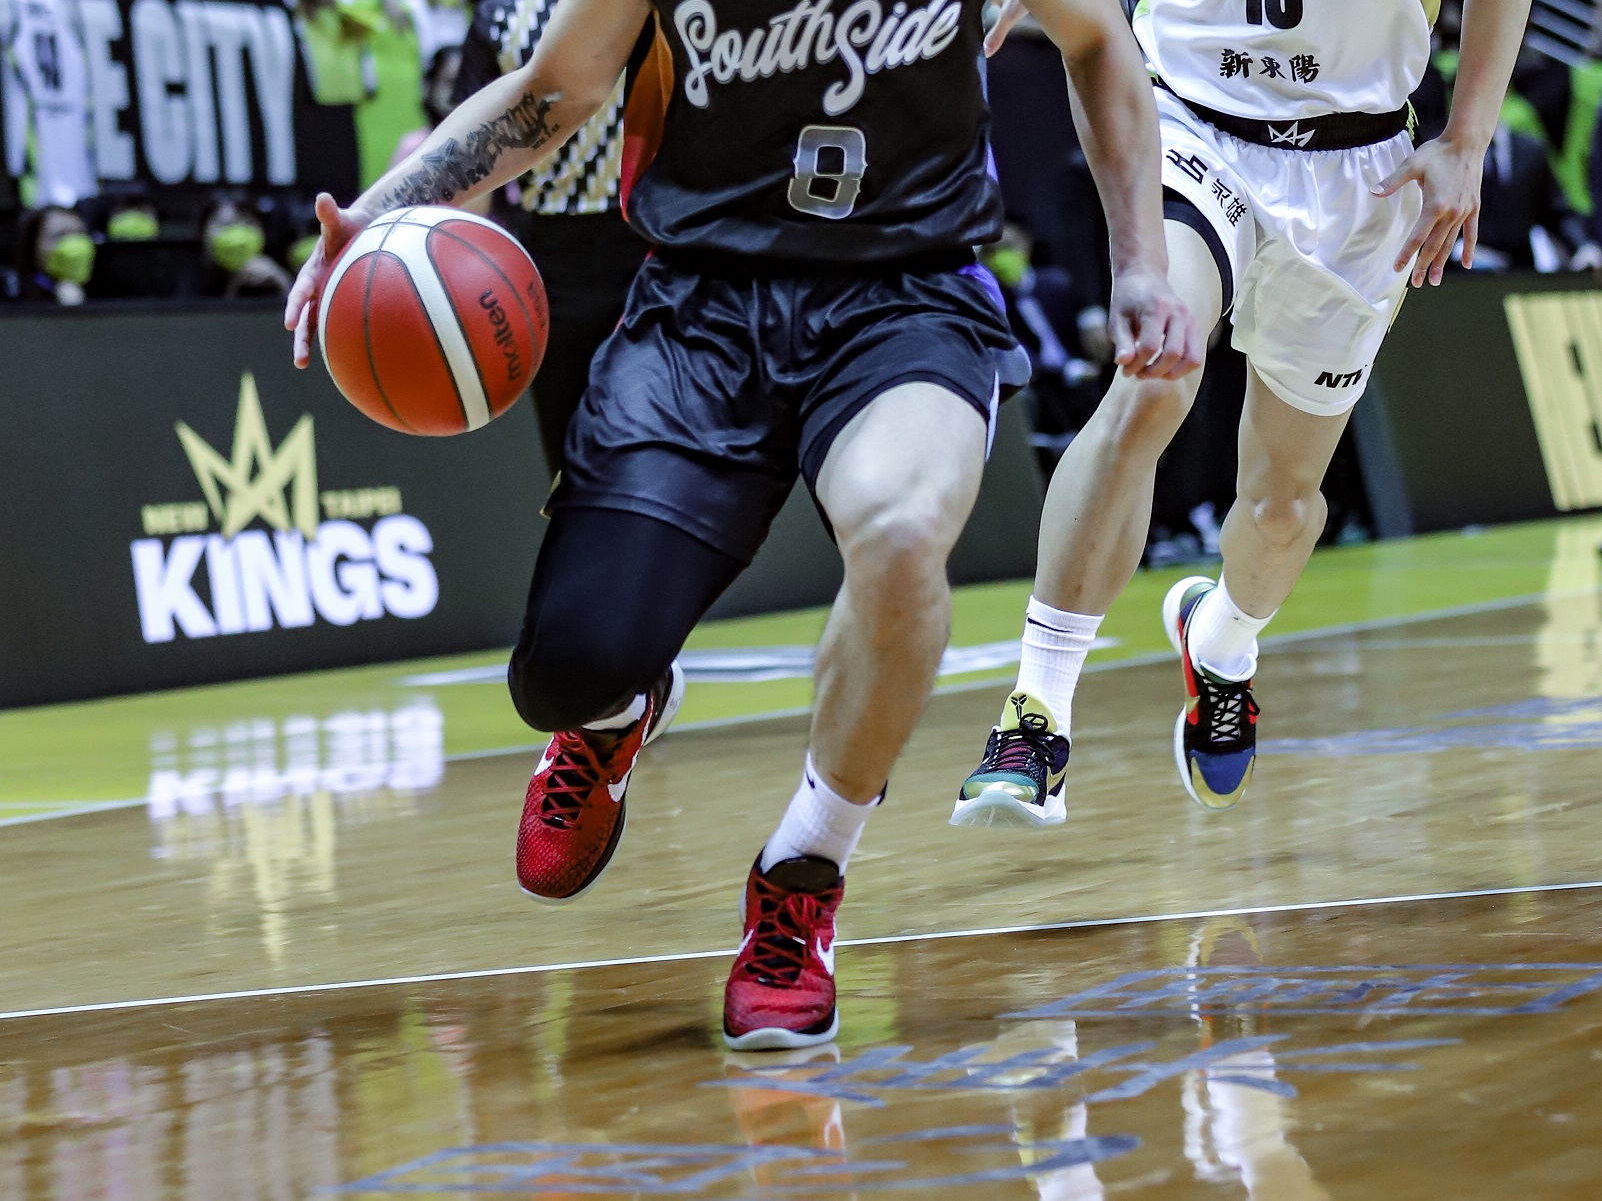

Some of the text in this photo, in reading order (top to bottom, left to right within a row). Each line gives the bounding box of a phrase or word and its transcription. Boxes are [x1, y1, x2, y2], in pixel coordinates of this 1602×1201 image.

[1219, 48, 1320, 84] 新東陽
[787, 125, 869, 220] 8
[478, 289, 522, 382] molten
[141, 486, 402, 536] NEW TAIPEI
[130, 513, 440, 644] KINGS
